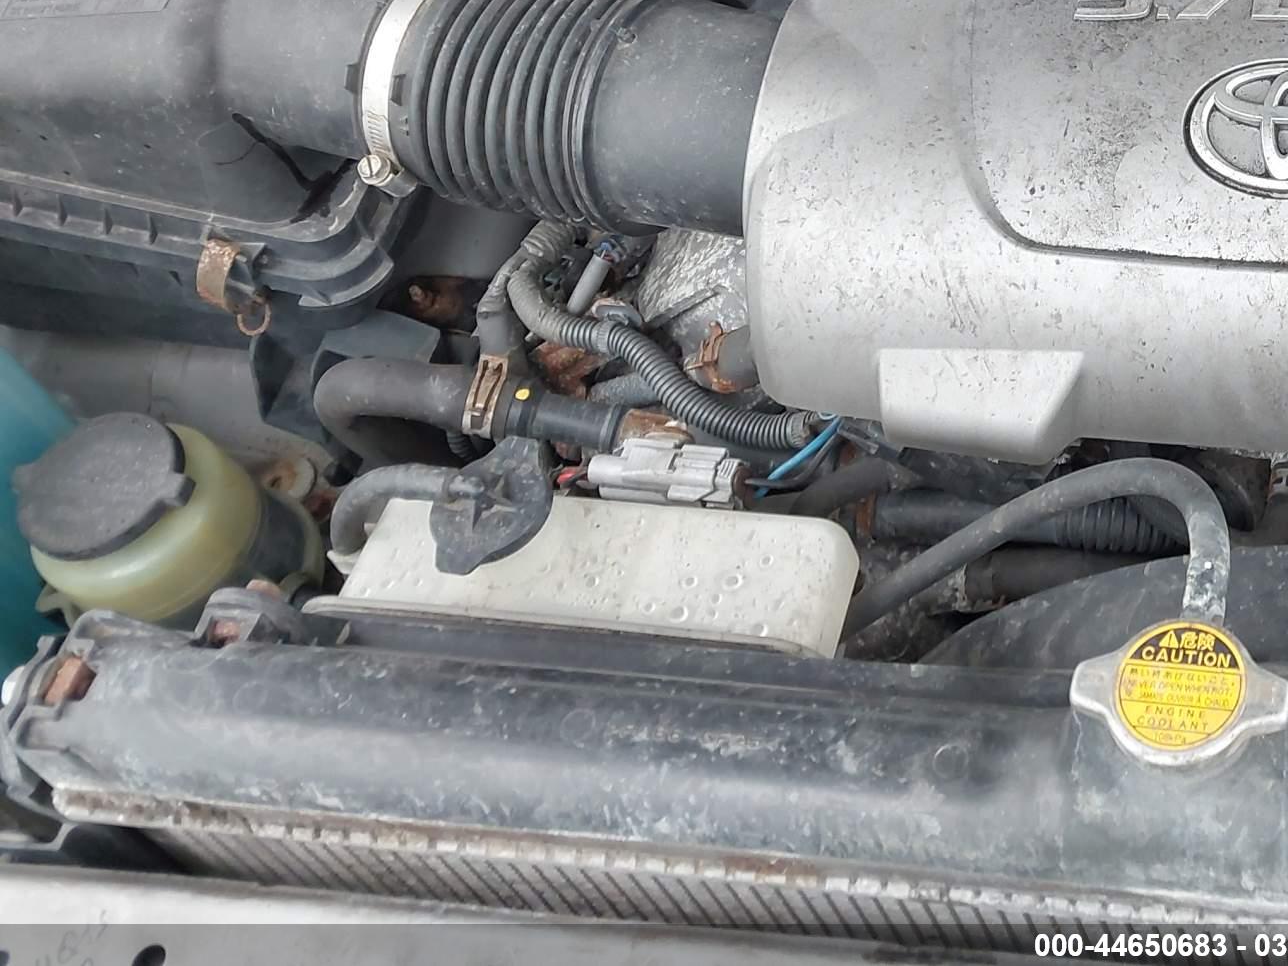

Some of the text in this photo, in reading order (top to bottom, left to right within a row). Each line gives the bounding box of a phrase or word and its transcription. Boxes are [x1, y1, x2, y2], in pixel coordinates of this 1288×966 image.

[1141, 645, 1232, 668] CAUTION
[1144, 705, 1206, 719] ENGINE
[1137, 715, 1209, 731] COOLANT
